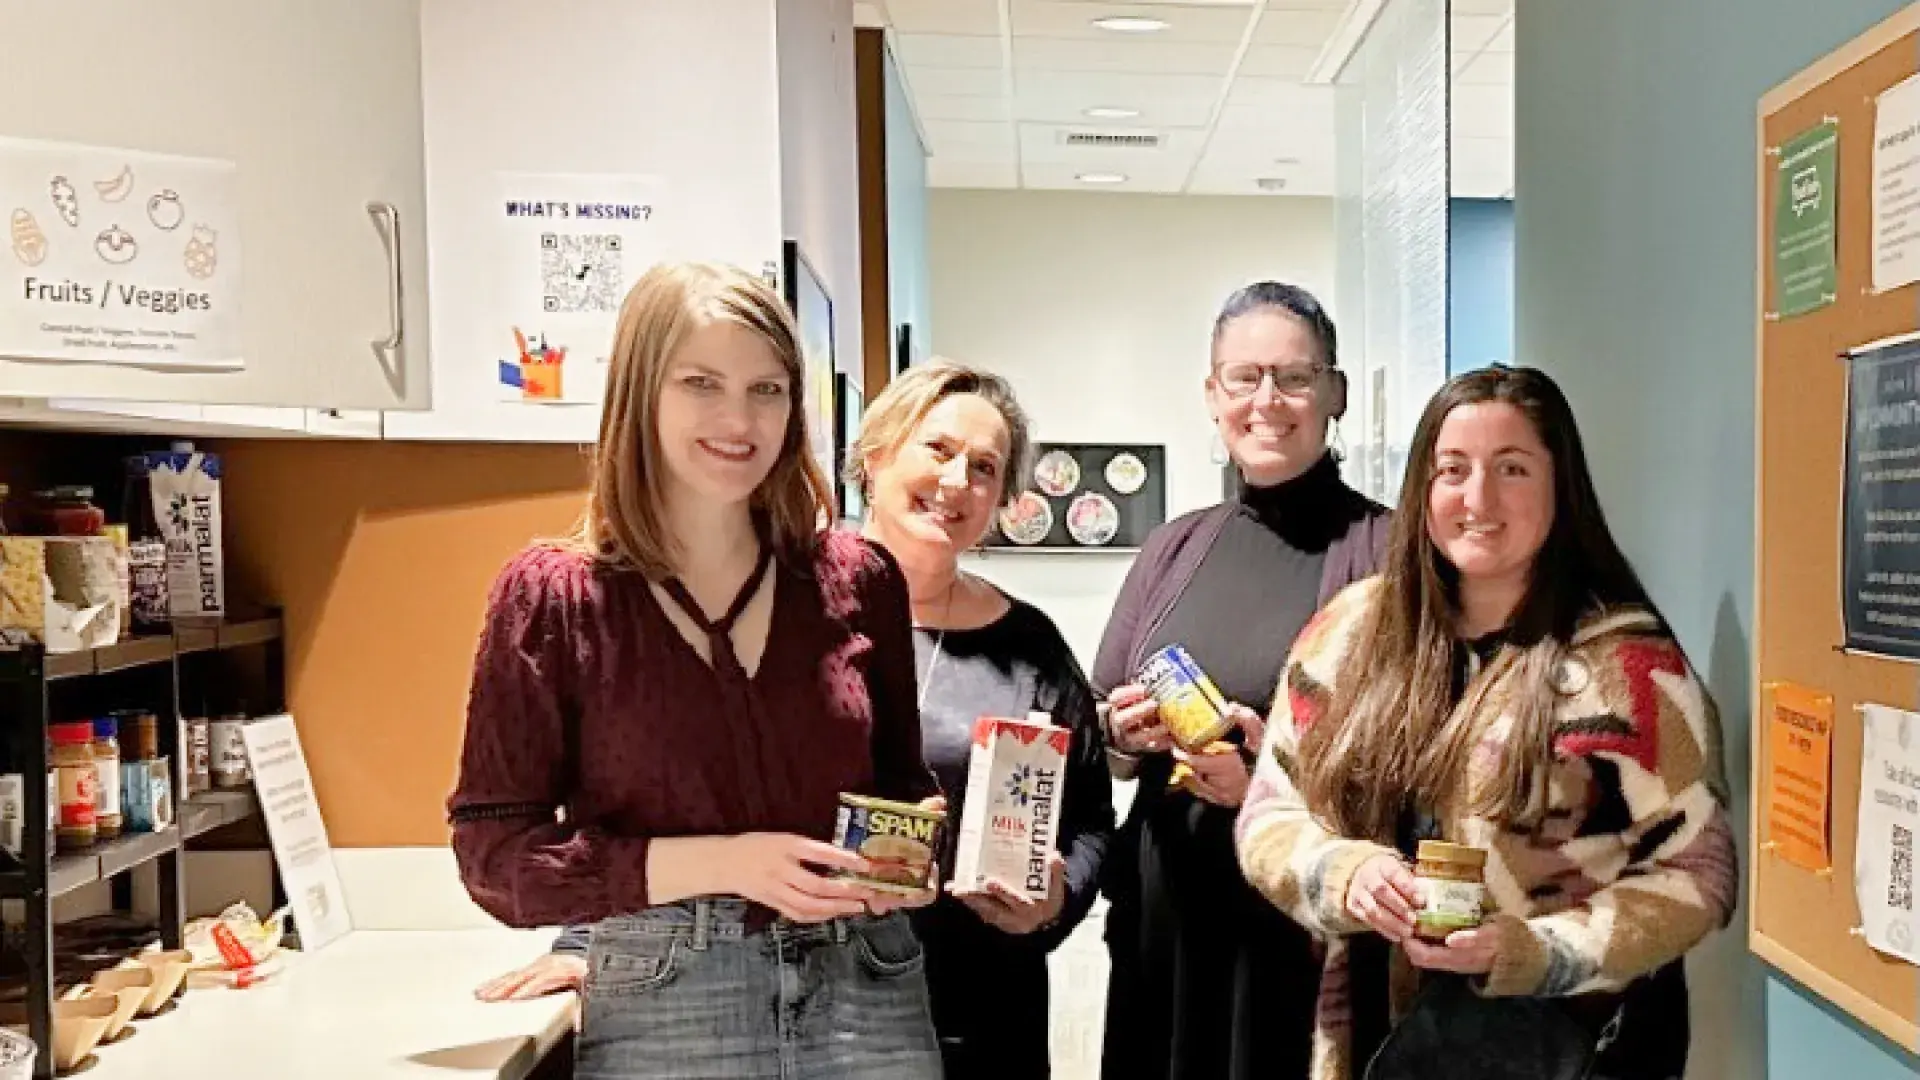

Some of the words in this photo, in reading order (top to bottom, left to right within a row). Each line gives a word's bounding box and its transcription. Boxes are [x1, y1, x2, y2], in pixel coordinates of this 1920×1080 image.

[506, 202, 569, 218] WHAT'S
[576, 204, 652, 221] MISSING?
[25, 277, 93, 304] Fruits
[99, 280, 112, 309] /
[119, 284, 211, 314] Veggies
[192, 495, 219, 611] parmalat
[868, 812, 934, 841] SPAM
[992, 815, 1026, 833] Milk
[1026, 767, 1056, 892] parmalat
